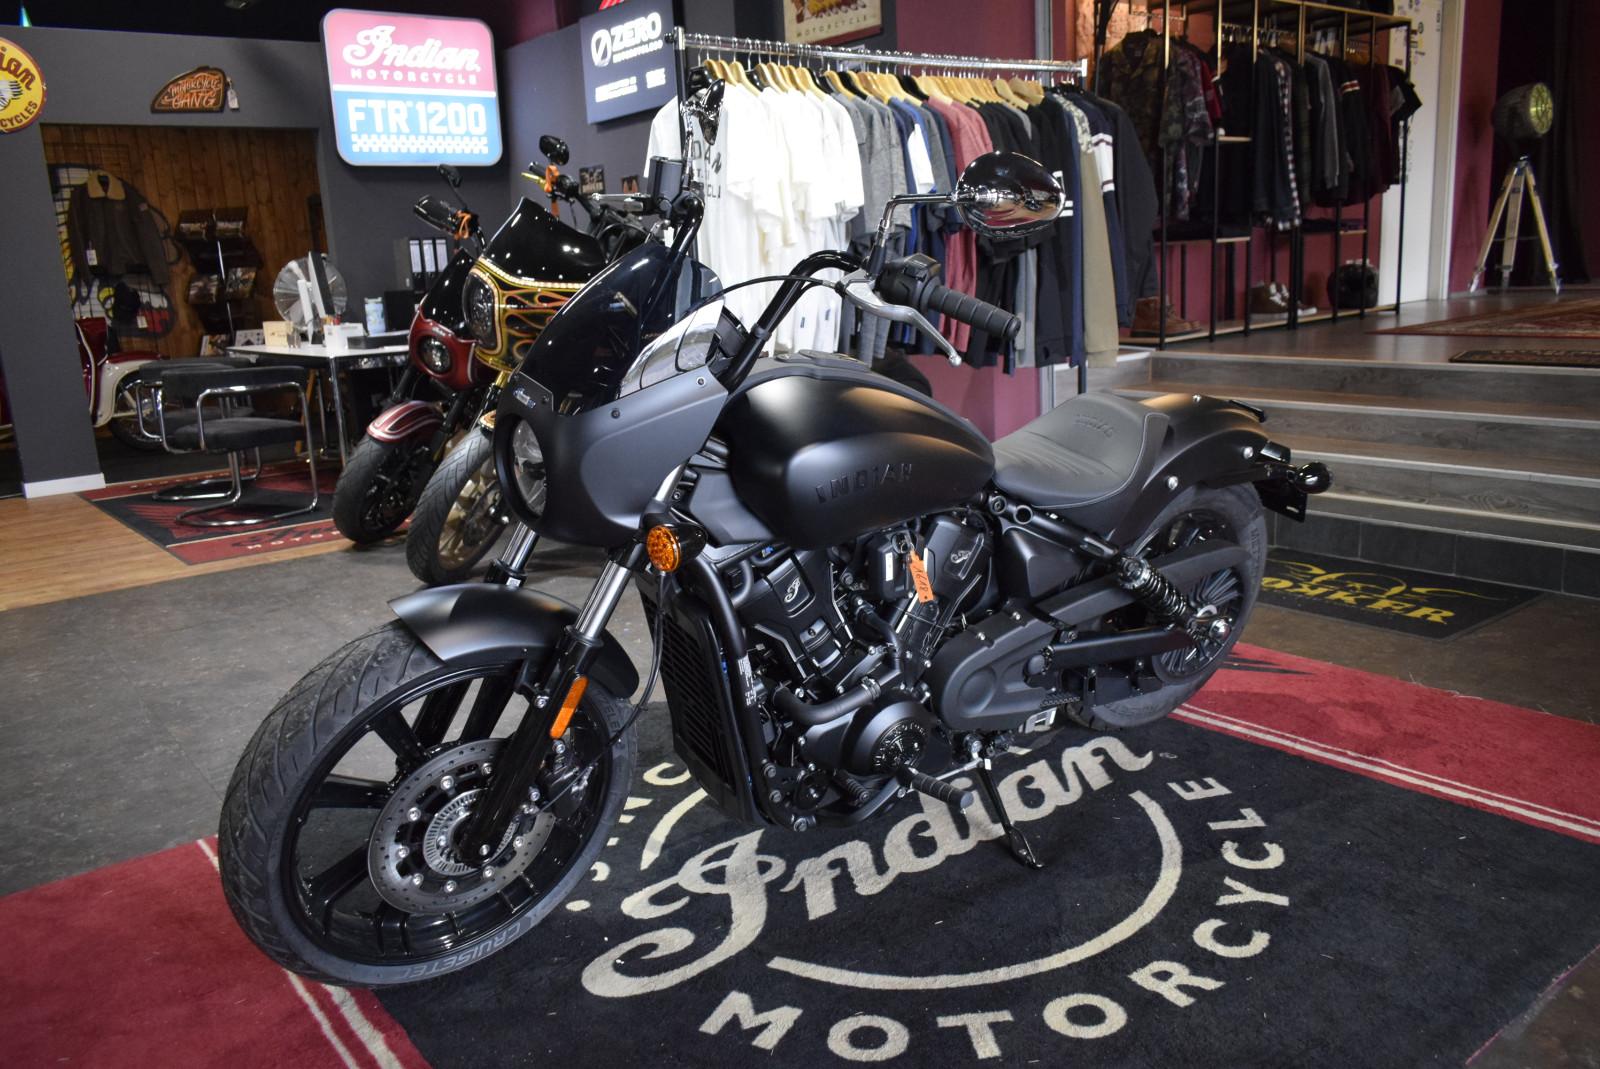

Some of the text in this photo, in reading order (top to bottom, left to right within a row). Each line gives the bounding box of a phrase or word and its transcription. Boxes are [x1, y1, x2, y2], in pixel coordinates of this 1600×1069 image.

[342, 25, 478, 70] Indian
[611, 12, 662, 53] ZERO
[351, 68, 477, 85] MOTORCYCLE
[172, 92, 217, 110] GANG
[415, 101, 487, 136] 1200
[581, 735, 1154, 998] Indian
[699, 775, 1290, 1062] MOTORCYCLE
